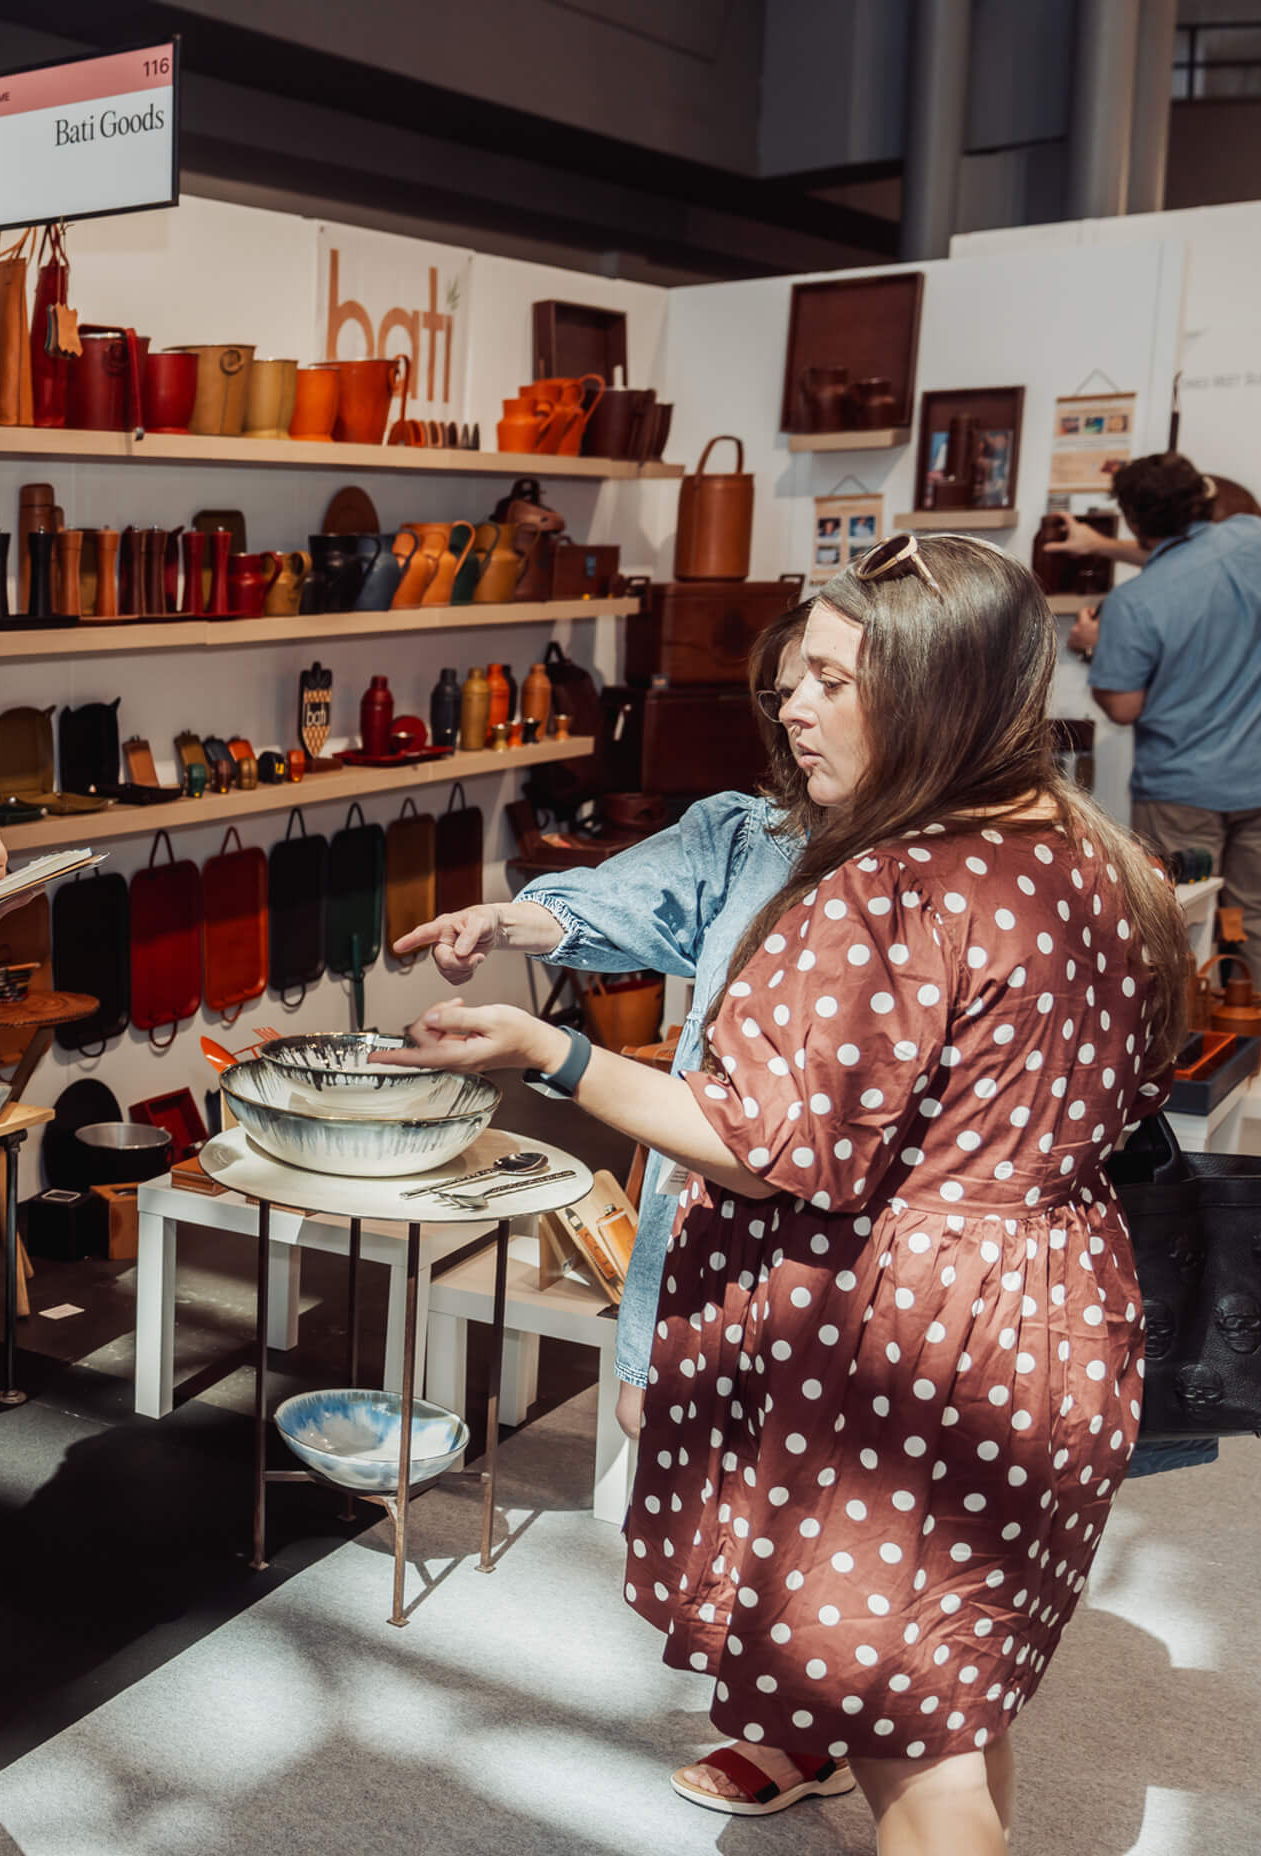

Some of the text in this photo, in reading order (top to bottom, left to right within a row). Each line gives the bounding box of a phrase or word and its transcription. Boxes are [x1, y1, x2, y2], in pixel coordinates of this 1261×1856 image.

[143, 57, 170, 77] 116
[55, 103, 165, 147] Bati Goods
